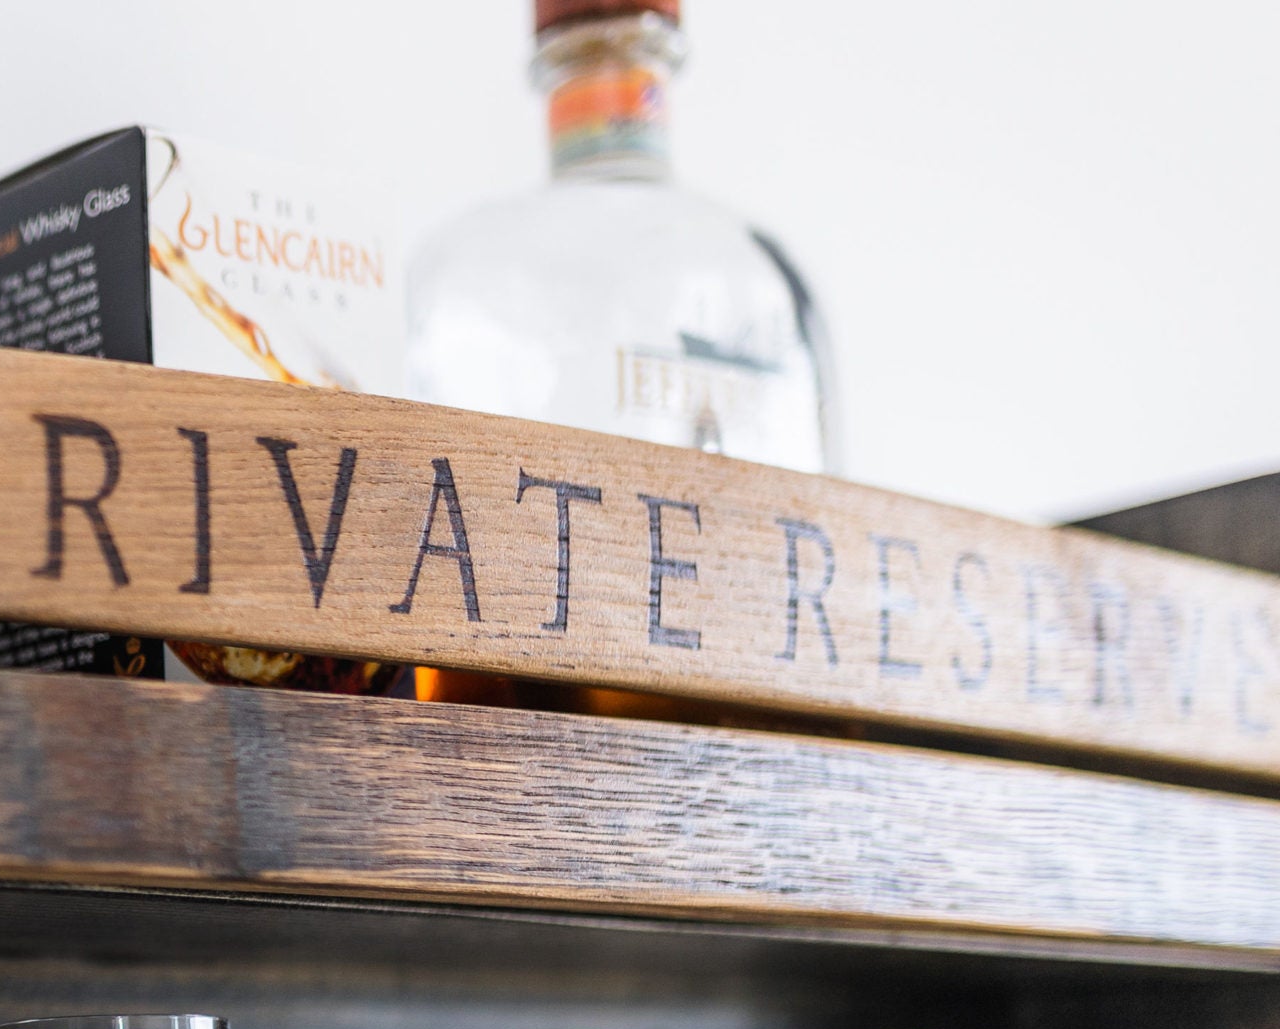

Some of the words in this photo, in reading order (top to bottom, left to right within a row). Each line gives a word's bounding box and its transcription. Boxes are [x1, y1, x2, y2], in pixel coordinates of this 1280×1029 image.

[20, 203, 82, 244] Whisky
[83, 184, 131, 217] Glass
[248, 190, 317, 225] THE
[178, 190, 386, 288] GLENCAIRN
[221, 268, 349, 311] GLASS
[773, 516, 1274, 737] RESERVE
